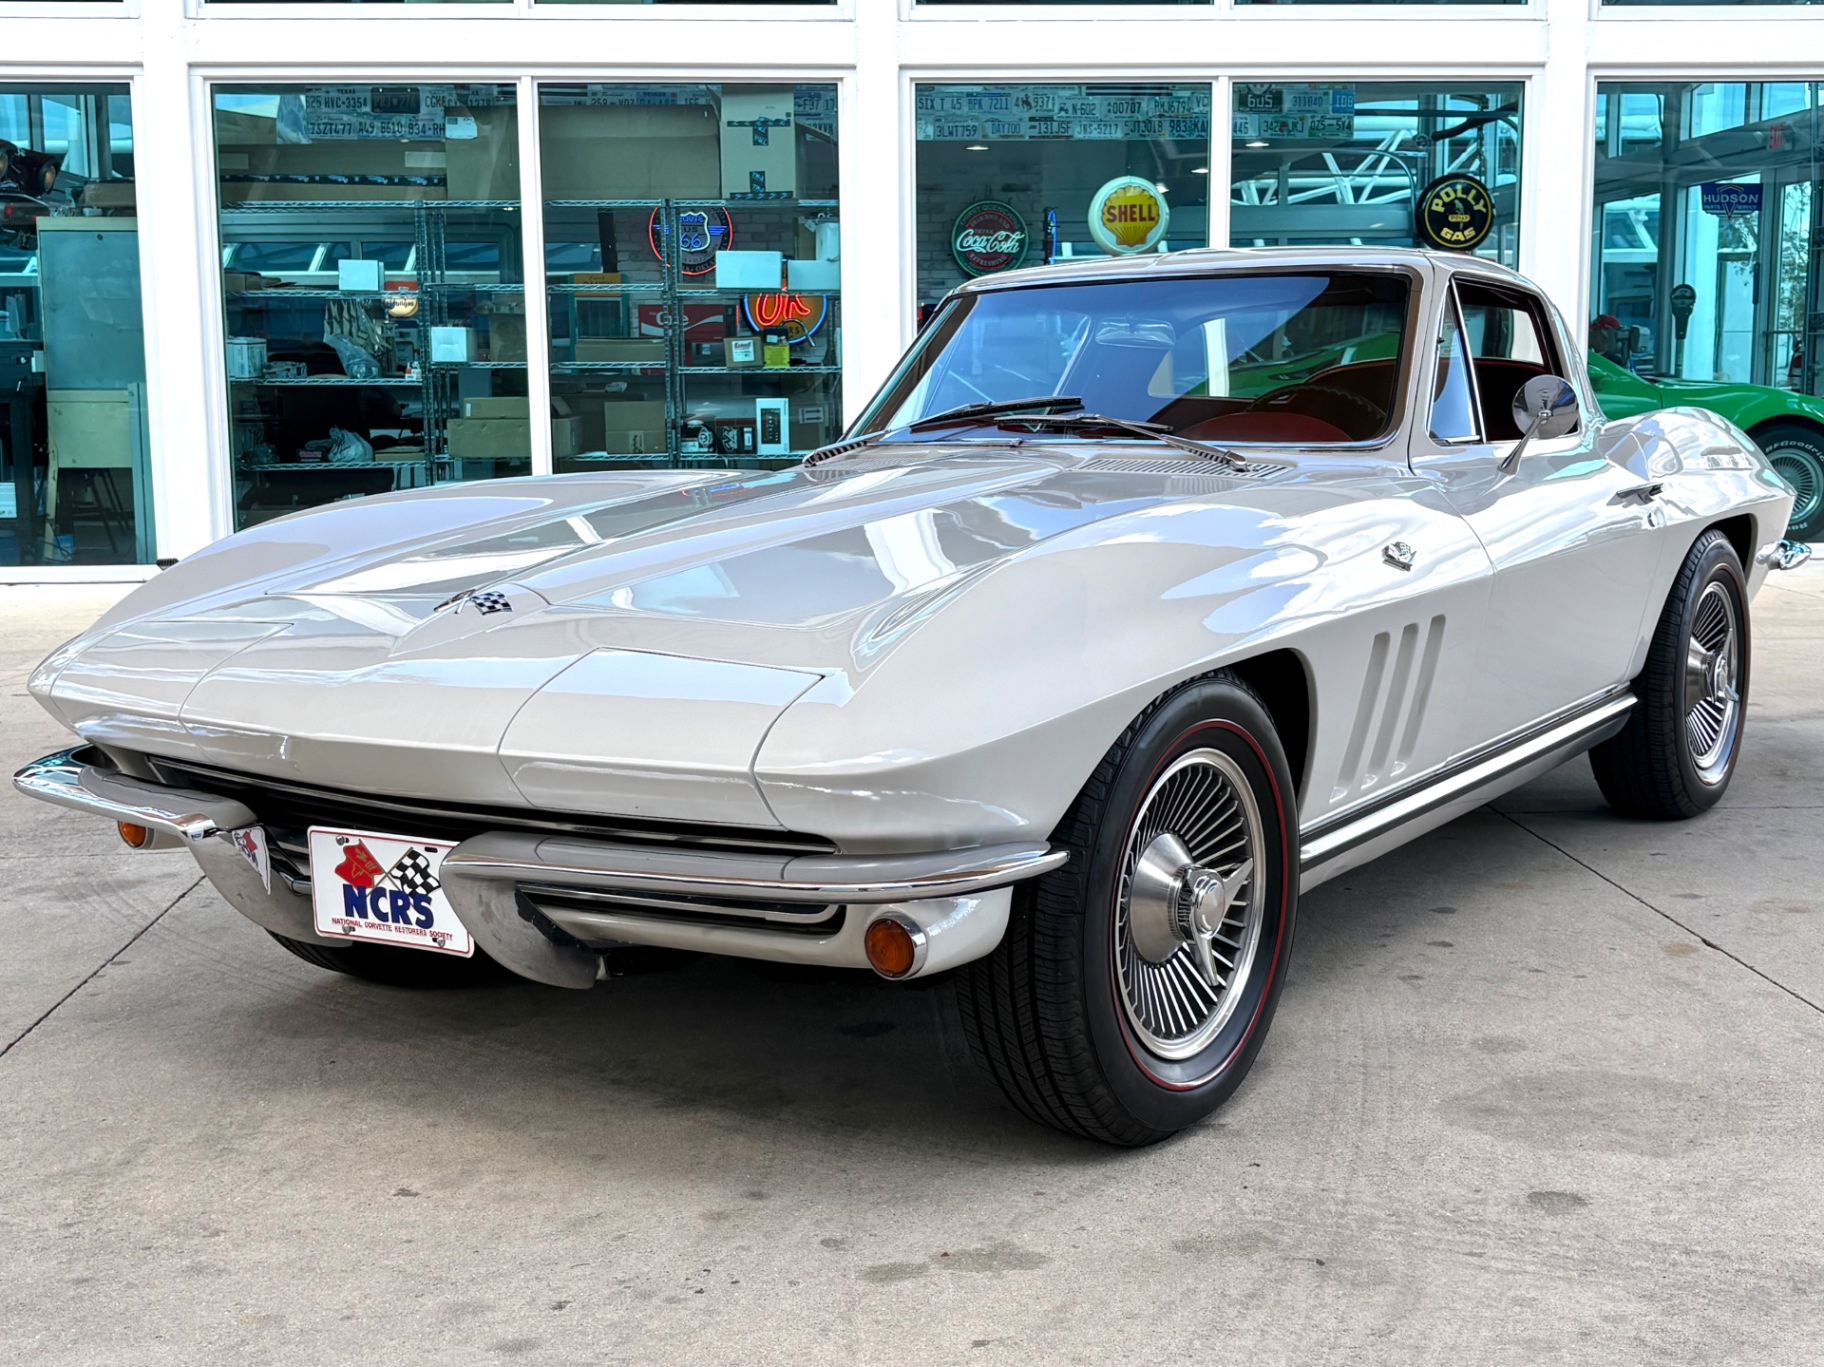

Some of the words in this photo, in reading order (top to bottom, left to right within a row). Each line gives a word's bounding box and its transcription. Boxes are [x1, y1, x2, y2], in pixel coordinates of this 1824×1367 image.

[408, 122, 445, 135] 834-RH
[936, 124, 978, 139] 3LWT759
[1169, 119, 1188, 133] 983
[1431, 184, 1487, 213] POLLY
[1703, 194, 1759, 203] HUDSON
[1106, 203, 1156, 223] SHELL
[681, 233, 702, 248] 66
[956, 228, 1025, 254] Coca-Cola
[1440, 227, 1476, 241] GAS
[1765, 440, 1824, 462] BFGoodric
[342, 883, 434, 930] NCRS
[331, 917, 363, 928] NATIONAL
[364, 921, 393, 932] CORVETTE
[394, 925, 428, 937] RESTORERS
[429, 930, 453, 941] SOCIETY
